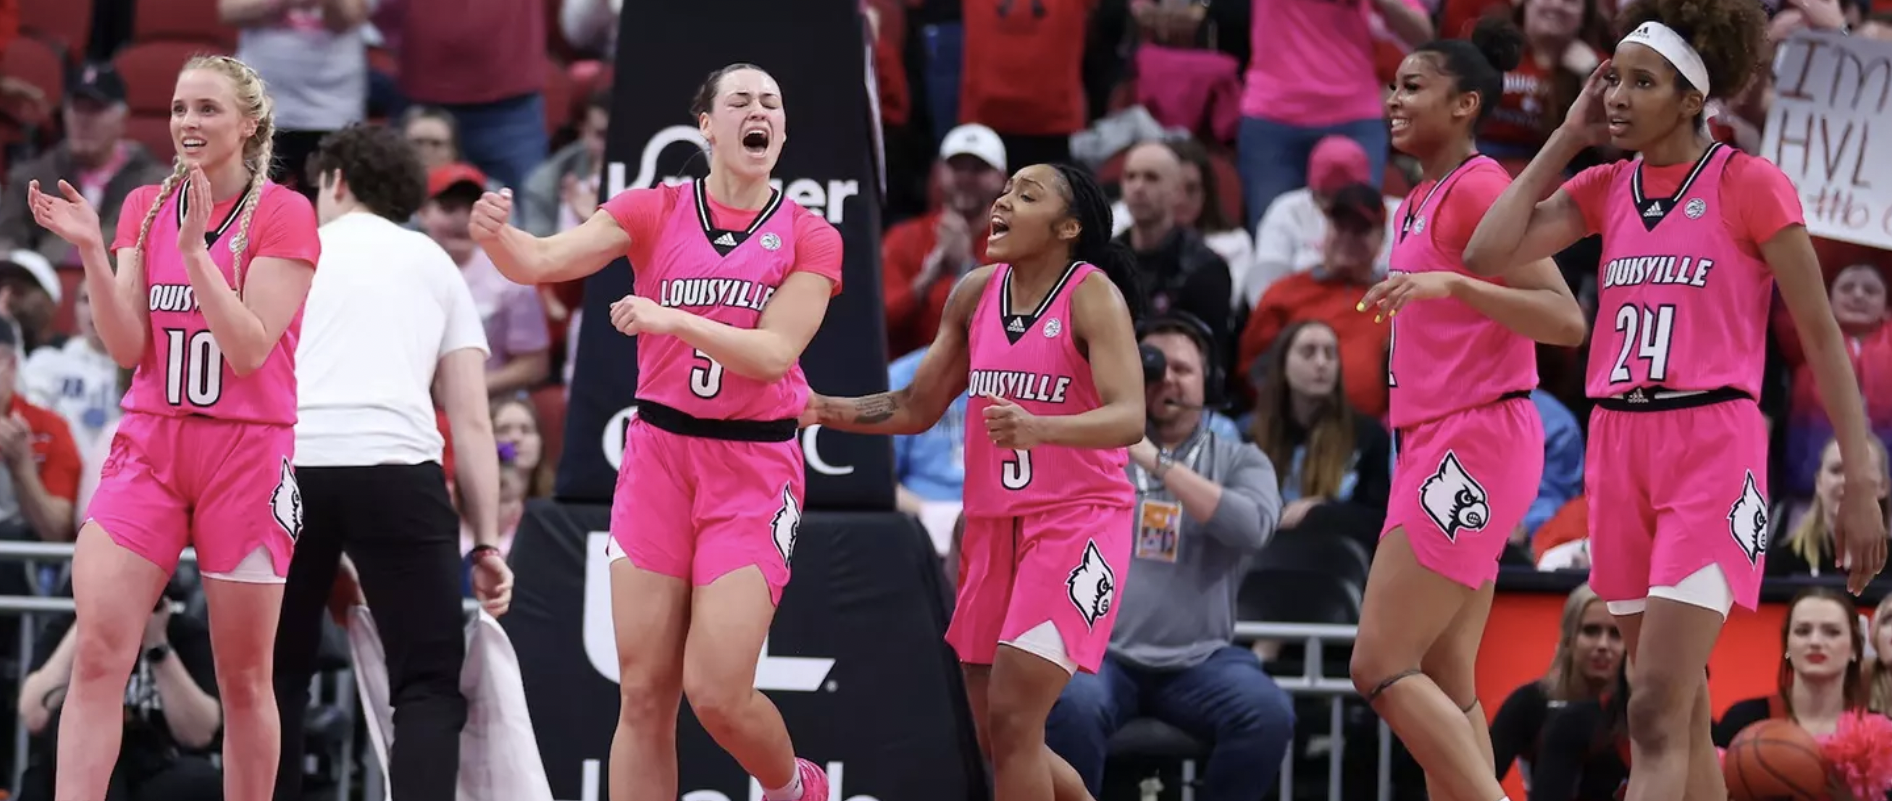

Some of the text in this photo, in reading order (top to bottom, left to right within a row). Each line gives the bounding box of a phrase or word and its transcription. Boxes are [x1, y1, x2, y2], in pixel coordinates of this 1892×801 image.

[1776, 107, 1872, 190] HVL
[162, 327, 224, 407] 10
[1609, 302, 1676, 384] 24
[967, 369, 1071, 403] OUISVILLE
